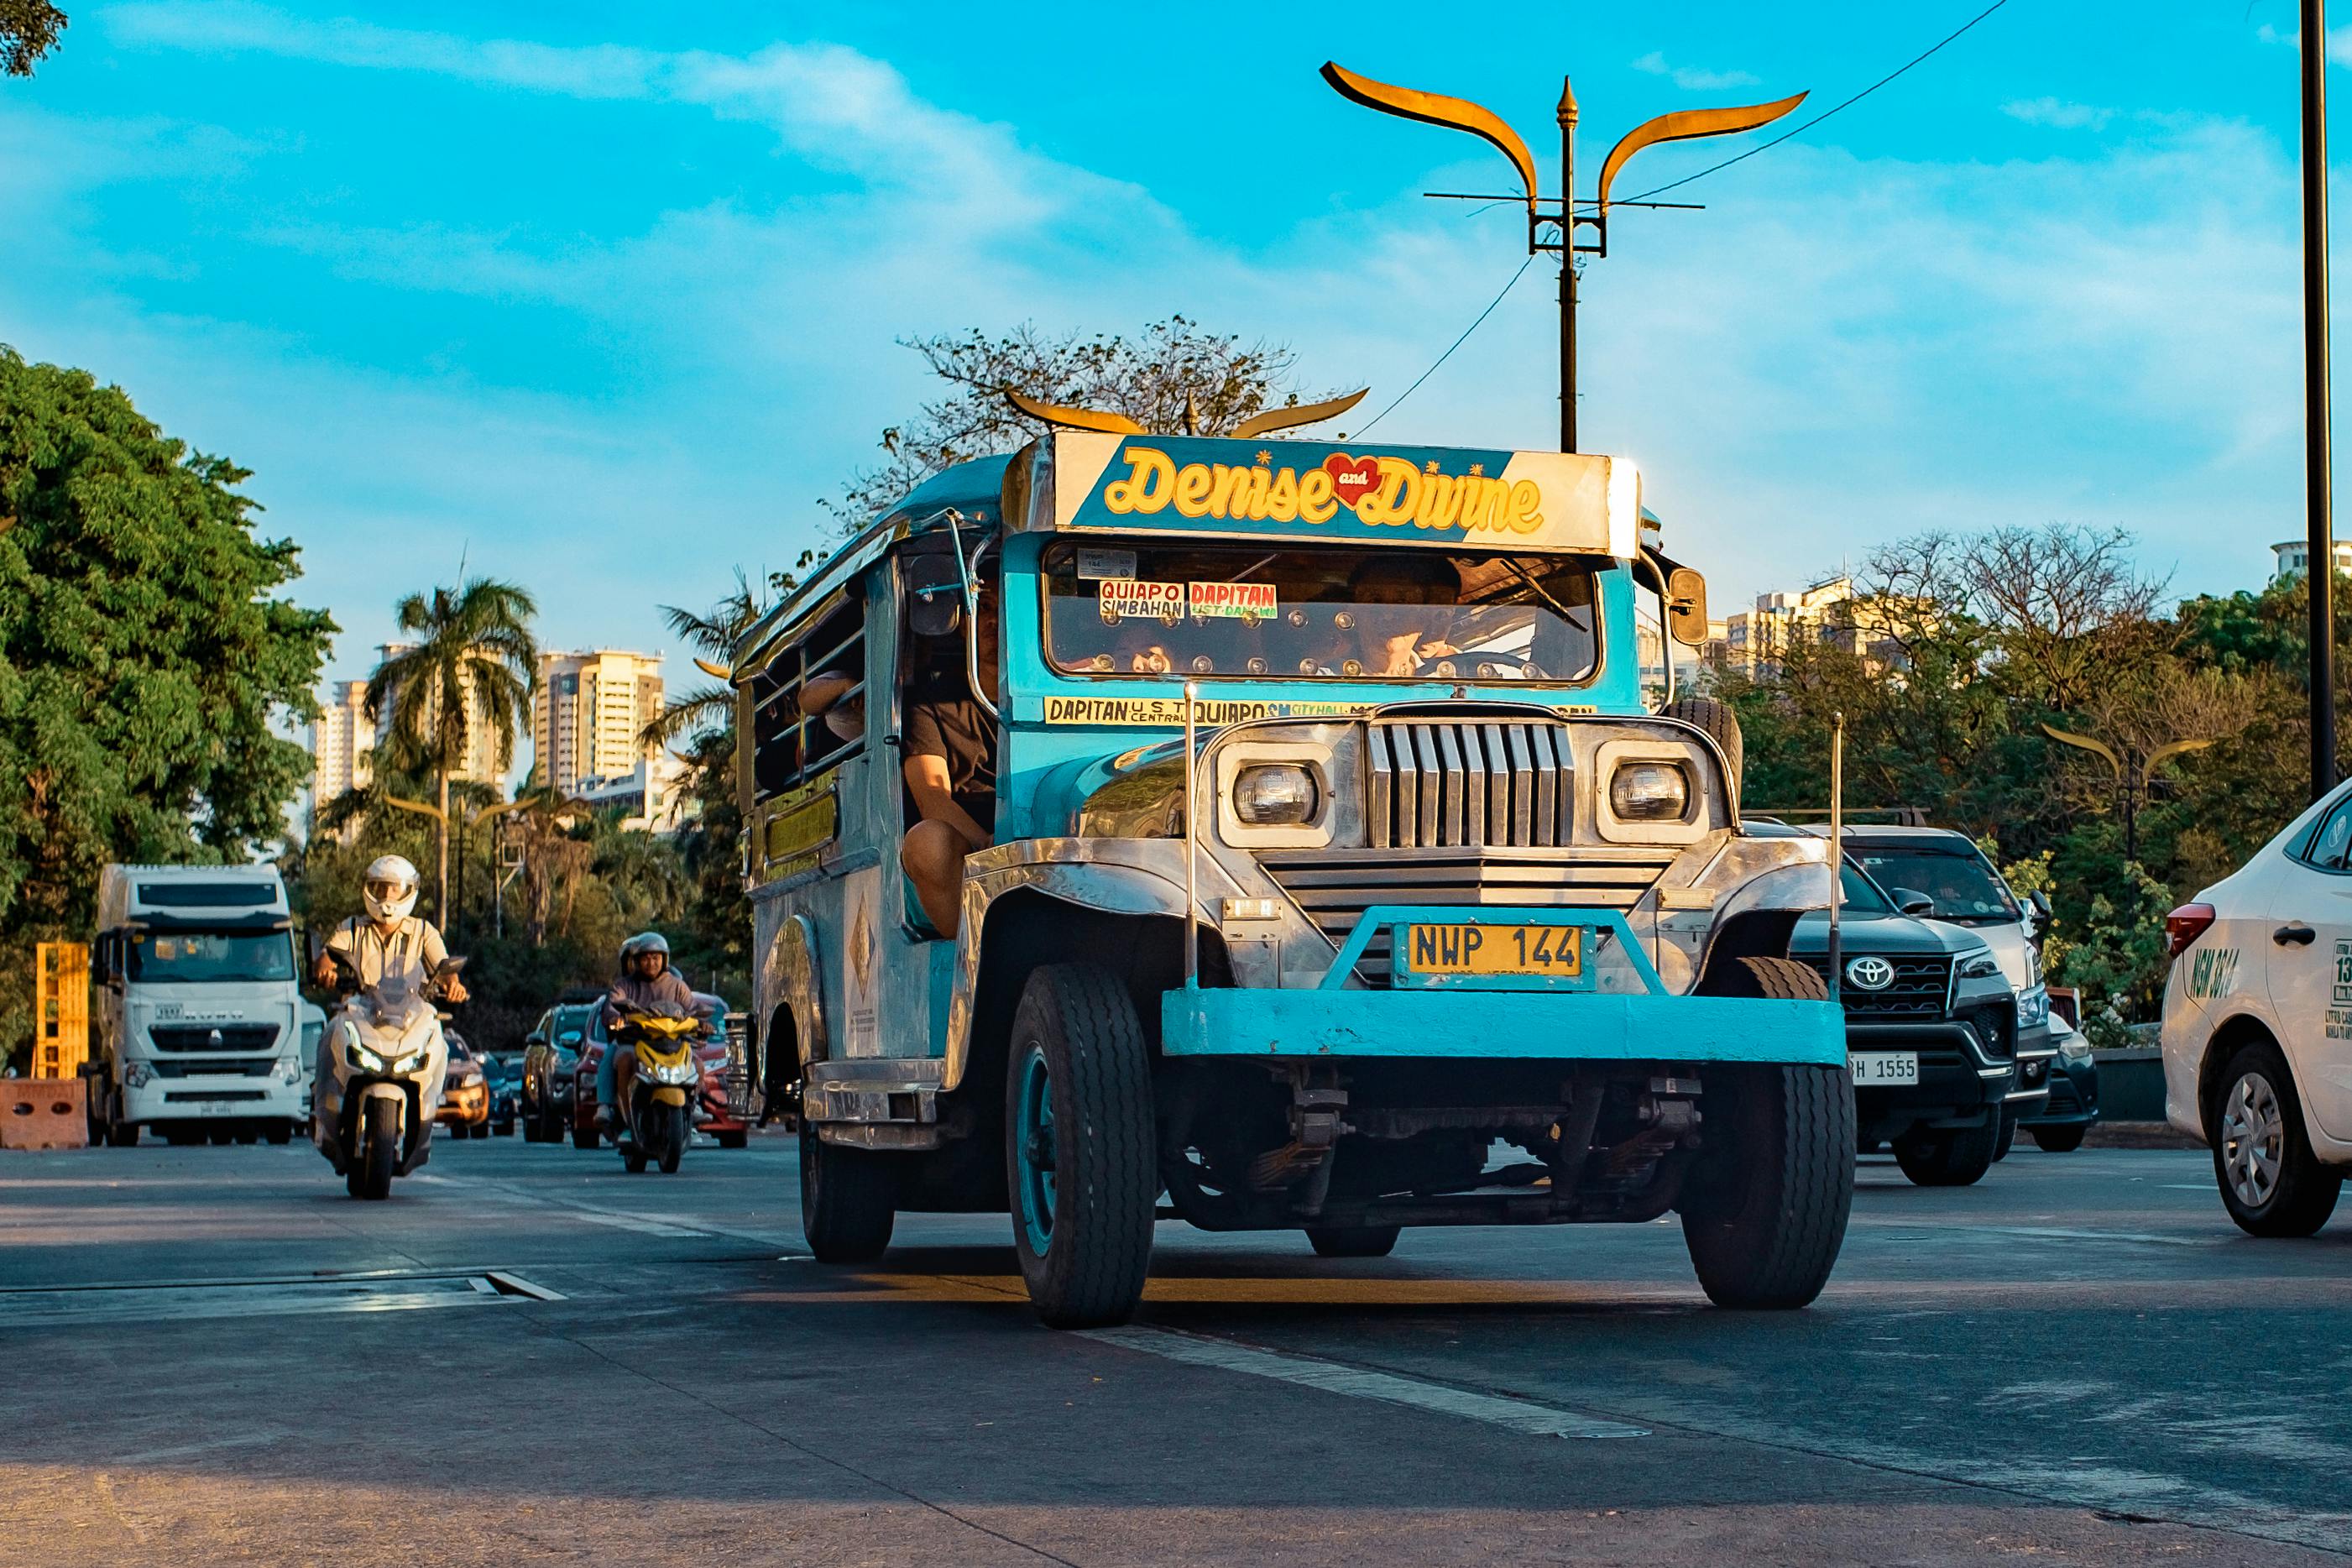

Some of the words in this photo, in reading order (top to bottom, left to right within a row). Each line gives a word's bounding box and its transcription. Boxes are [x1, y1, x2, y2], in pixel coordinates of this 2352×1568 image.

[1105, 447, 1338, 524] Denise
[1339, 471, 1369, 485] and
[1356, 457, 1544, 534] Divine
[1102, 582, 1179, 600] QUIAPO
[1191, 585, 1274, 607] DAPITAN
[1102, 599, 1181, 617] SIMBAHAN
[1050, 699, 1128, 721] DAPITAN
[1131, 713, 1185, 722] CENTRAL
[1194, 702, 1264, 723] QUIAPO
[1416, 926, 1483, 965] NWP
[1513, 928, 1575, 967] 144
[1876, 1059, 1915, 1078] 1555
